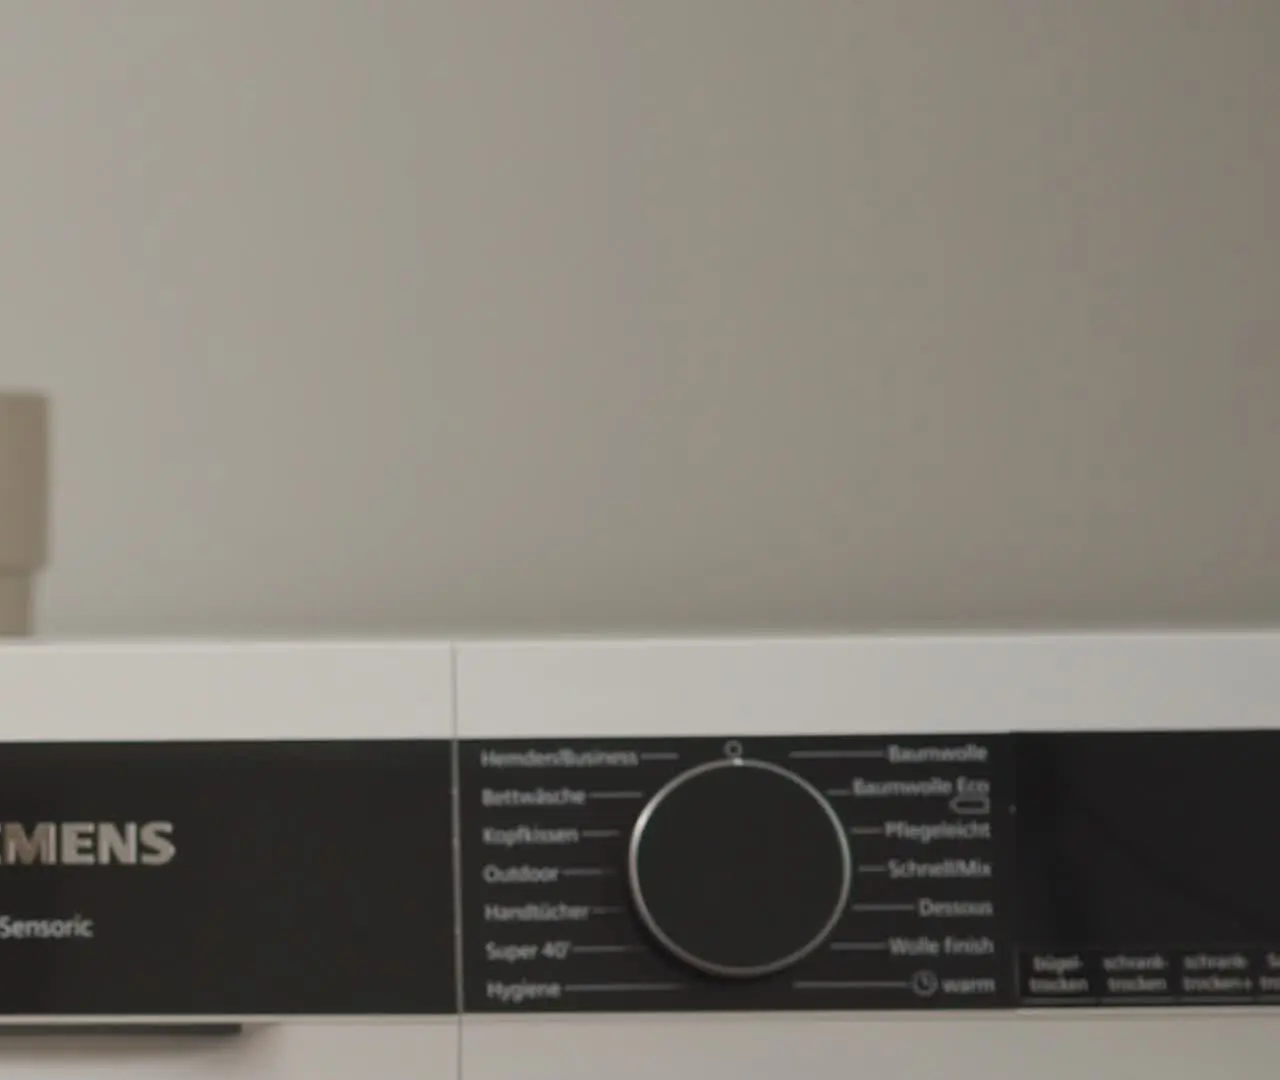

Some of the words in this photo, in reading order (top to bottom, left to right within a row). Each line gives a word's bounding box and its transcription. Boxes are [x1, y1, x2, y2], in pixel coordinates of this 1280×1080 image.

[887, 744, 988, 763] Baumwolle
[852, 777, 952, 796] Baumwolle
[956, 776, 990, 795] Eco
[481, 787, 586, 807] Bettwäsche
[482, 825, 579, 848] Kopfkissen
[884, 820, 991, 843] Pflegeleicht
[483, 864, 559, 883] Outdoor
[484, 902, 589, 922] Handtücher
[918, 898, 993, 917] Dessous
[485, 941, 539, 963] Super
[888, 937, 941, 956] Wolle
[486, 979, 562, 1003] Hygiene
[942, 978, 996, 995] warm
